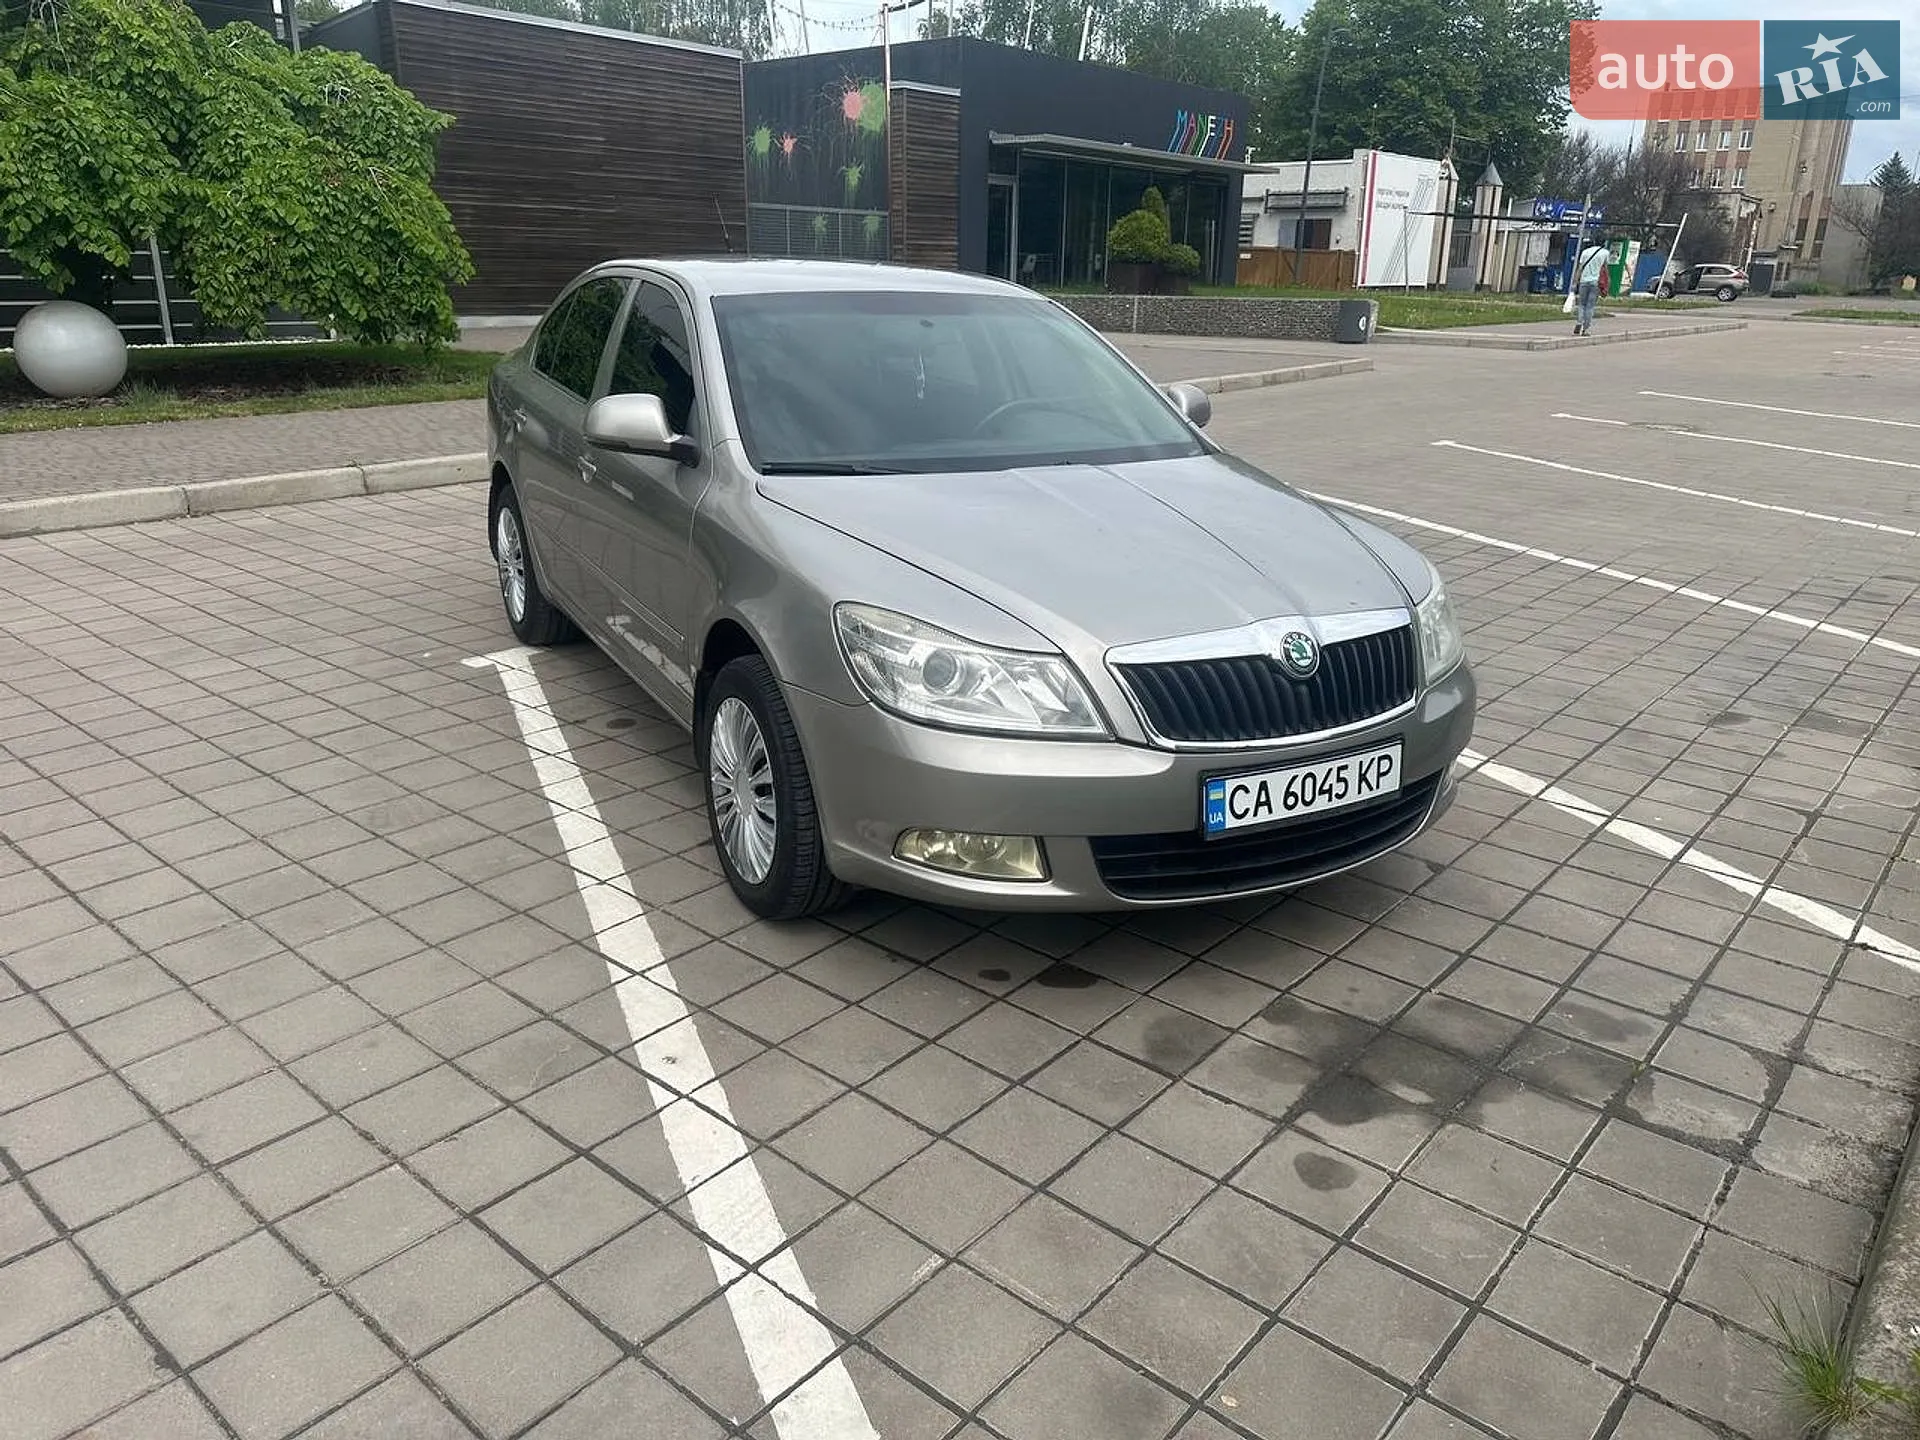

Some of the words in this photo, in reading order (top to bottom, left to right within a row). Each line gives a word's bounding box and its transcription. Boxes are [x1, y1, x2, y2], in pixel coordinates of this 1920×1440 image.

[1229, 780, 1273, 820] CA
[1282, 764, 1349, 811] 6045
[1357, 754, 1393, 795] KP
[1209, 811, 1224, 825] UA
